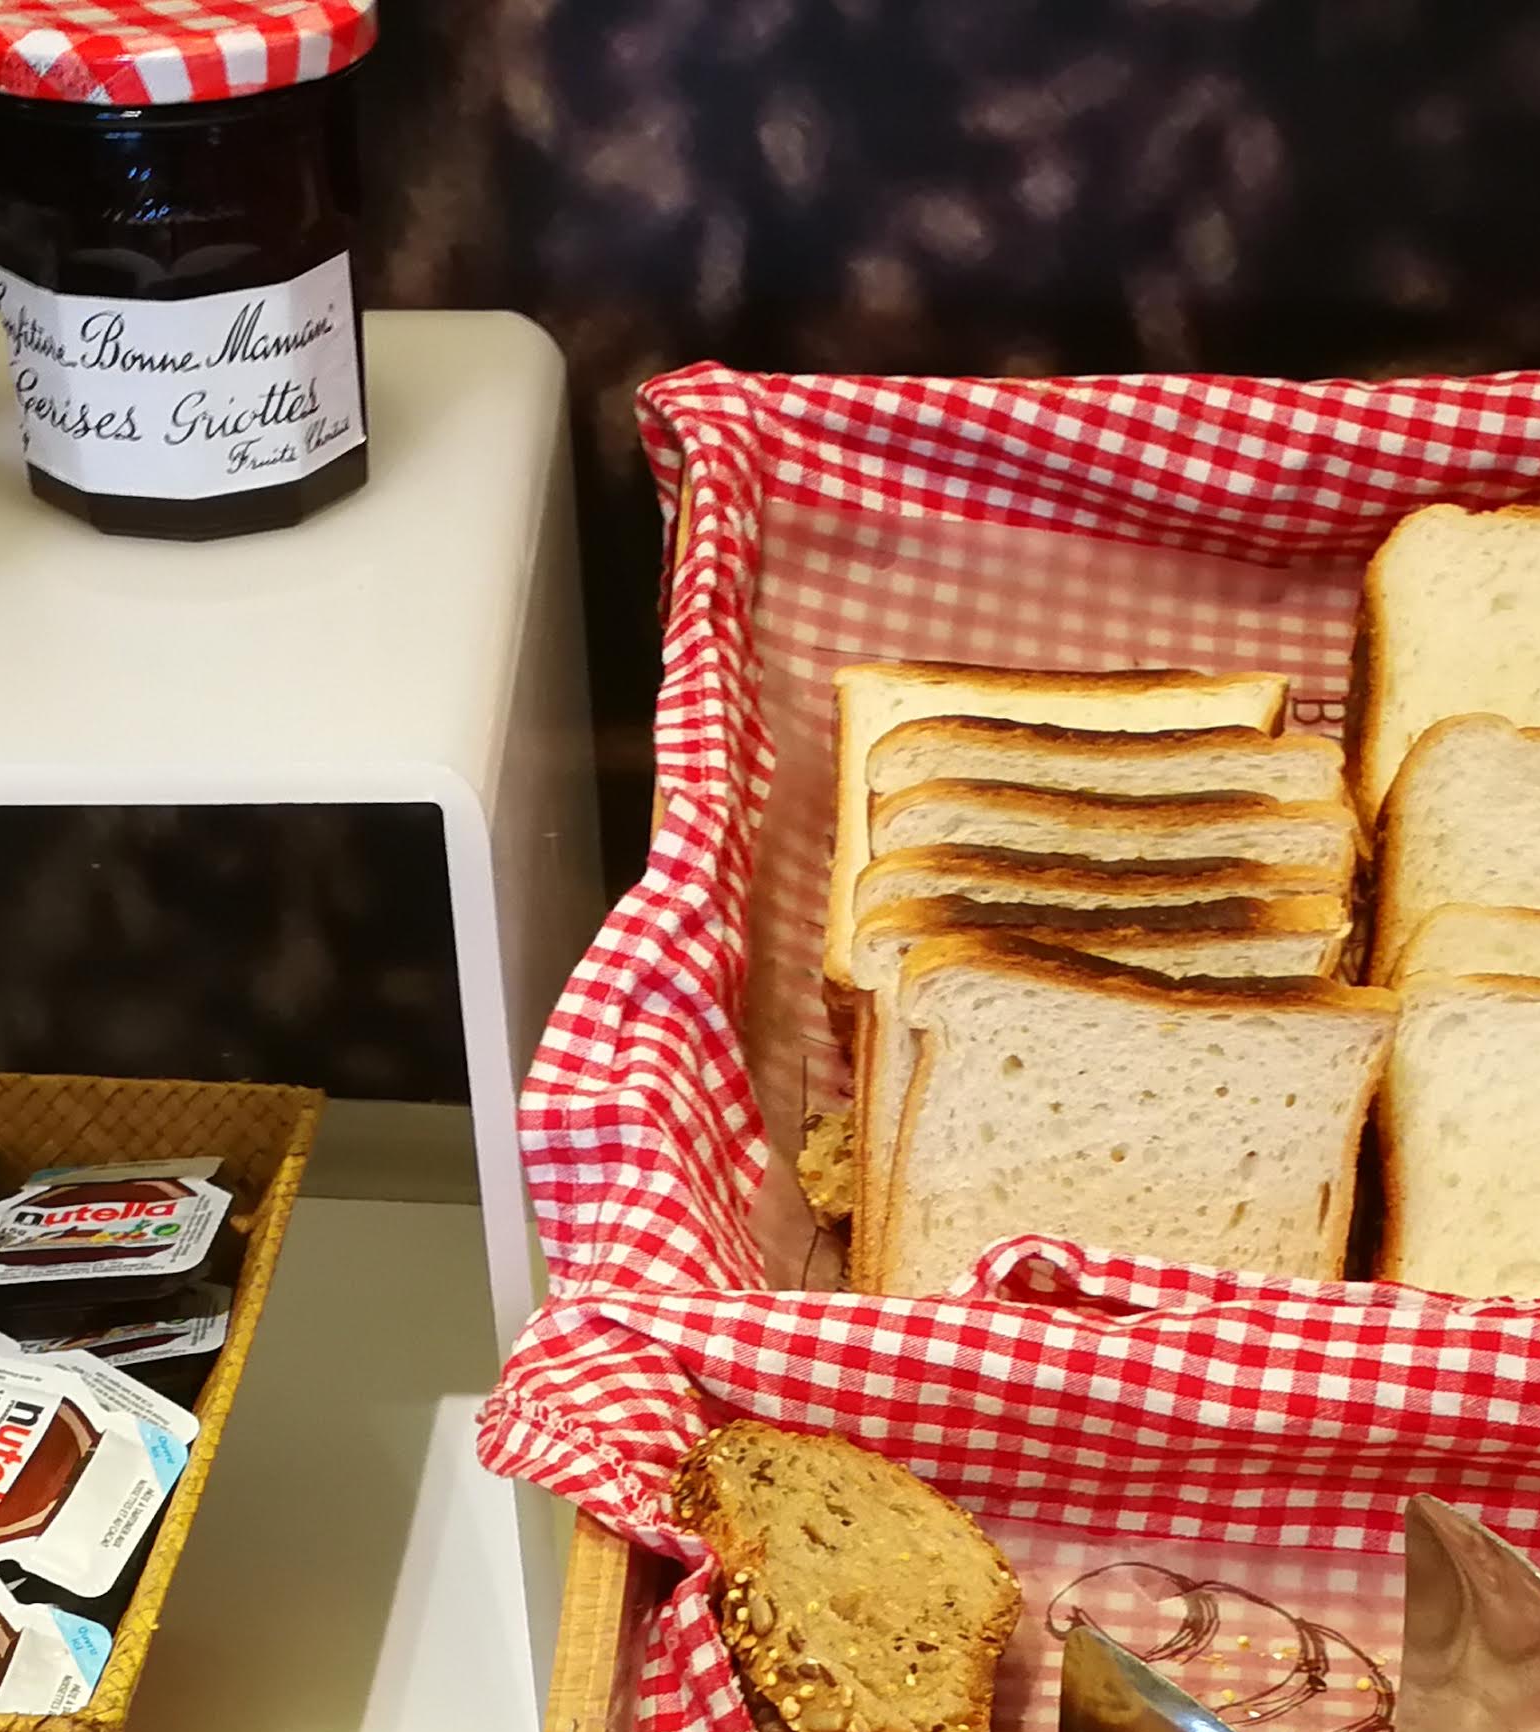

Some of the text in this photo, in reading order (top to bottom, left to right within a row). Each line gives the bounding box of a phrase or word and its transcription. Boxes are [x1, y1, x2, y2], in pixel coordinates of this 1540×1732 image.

[80, 310, 200, 372] Bonne
[206, 300, 334, 368] Maman
[164, 378, 320, 445] Griottes
[14, 1199, 177, 1228] nutella
